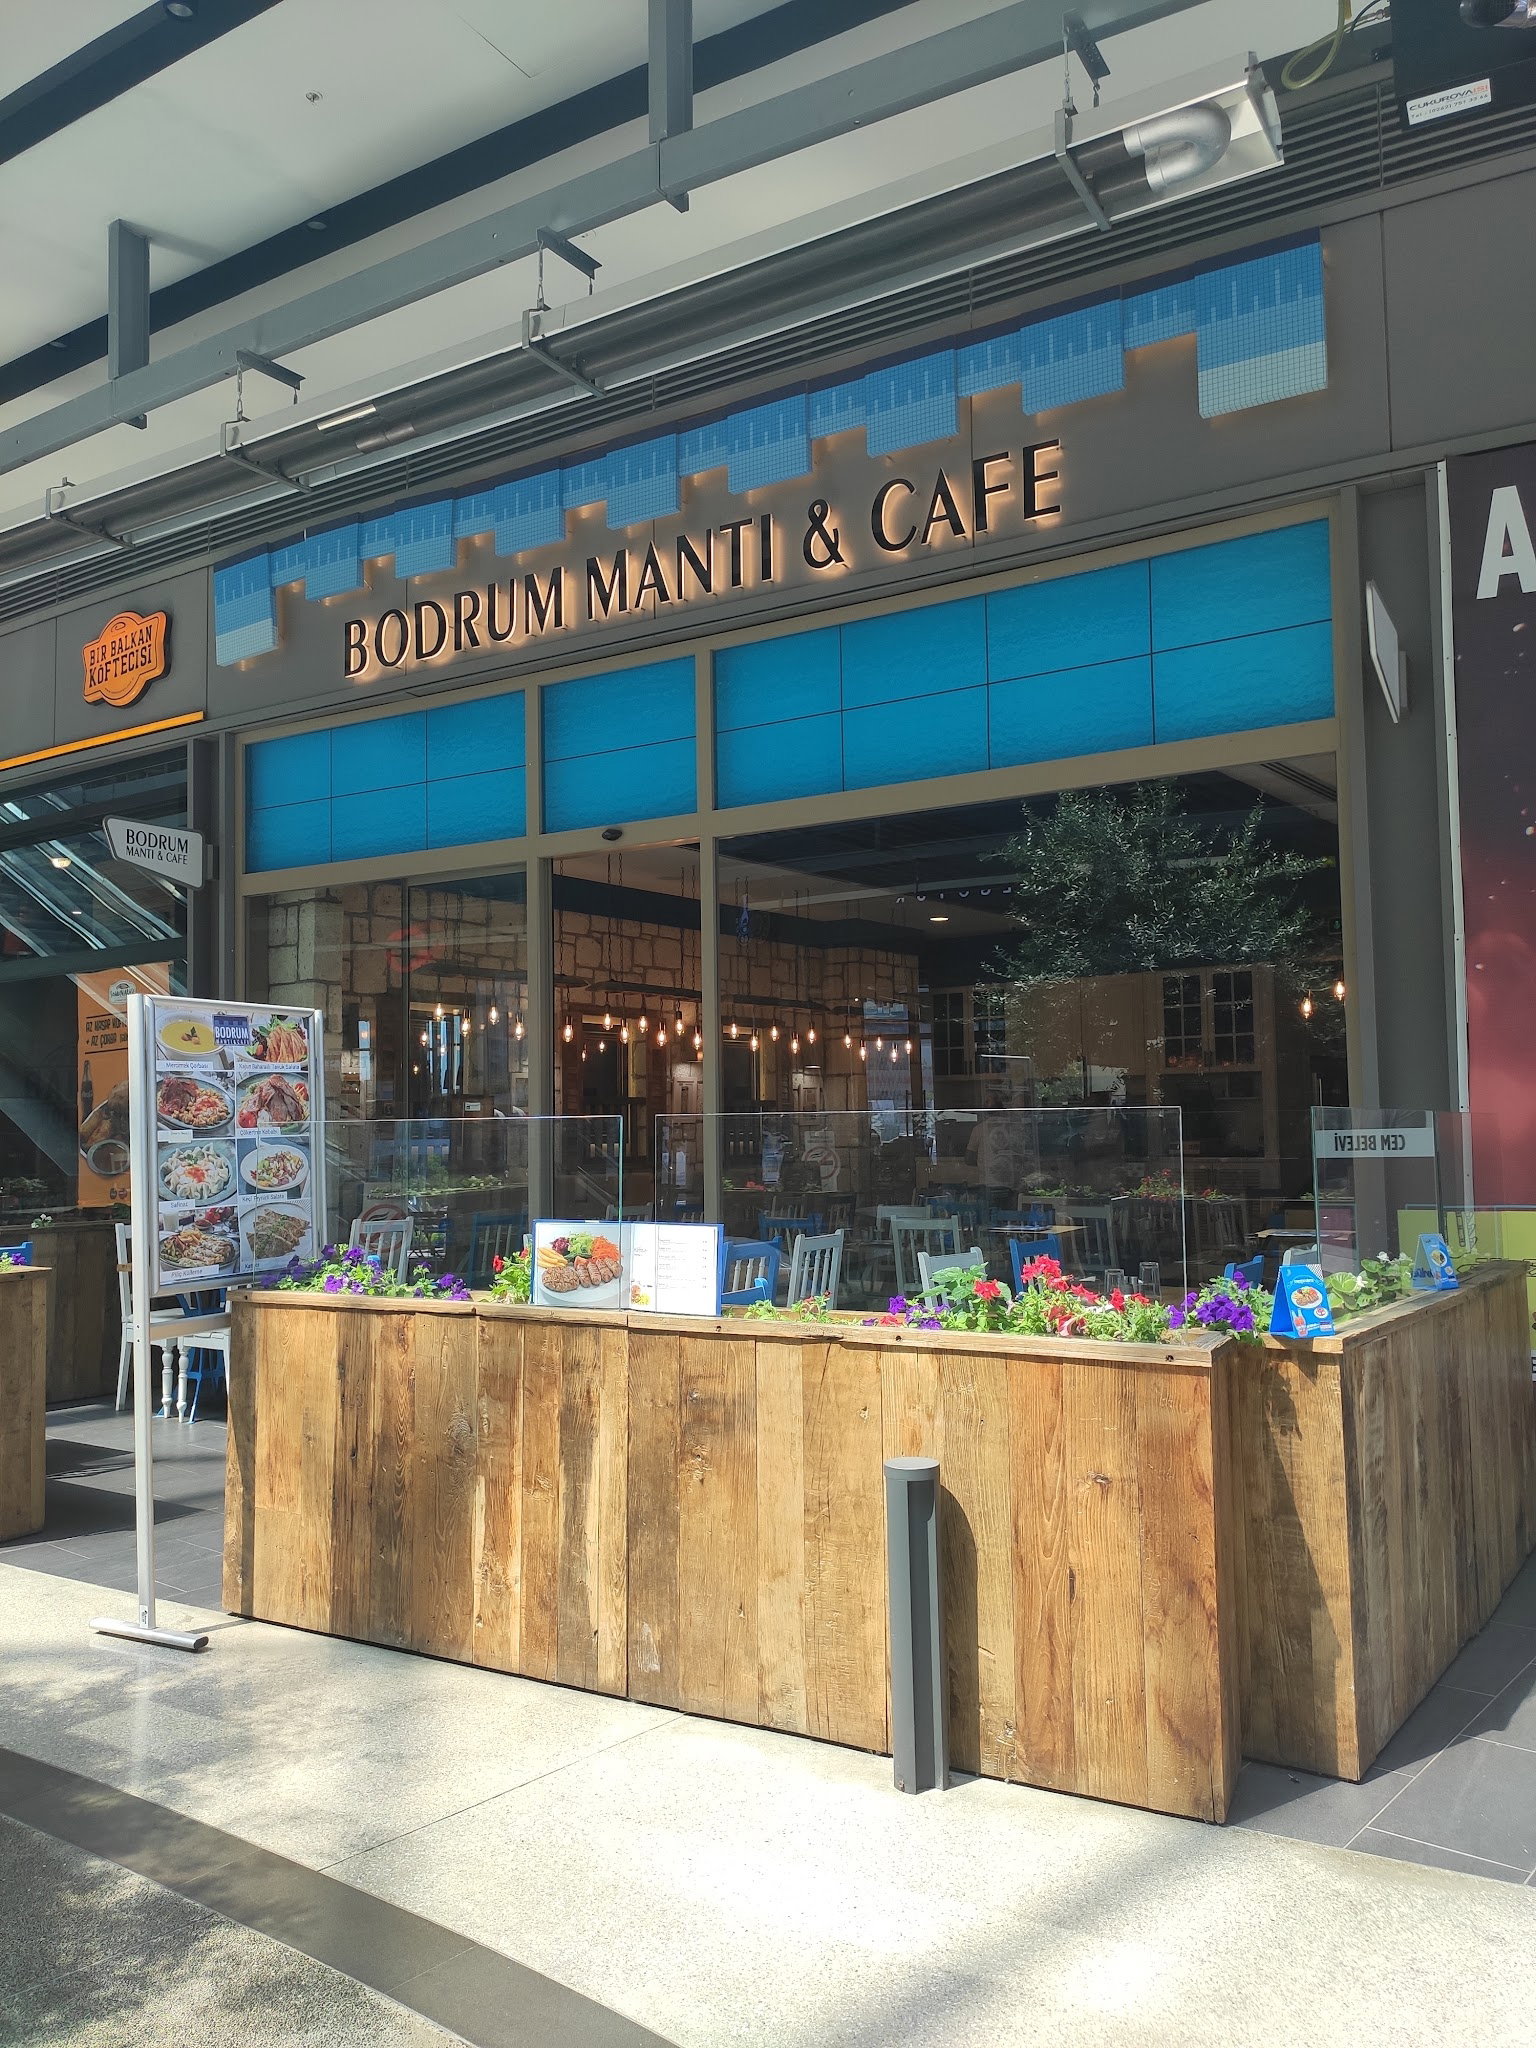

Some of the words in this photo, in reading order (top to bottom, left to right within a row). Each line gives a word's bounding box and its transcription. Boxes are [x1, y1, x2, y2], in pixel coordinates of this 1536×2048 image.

[344, 566, 566, 679] BODRUM
[586, 513, 774, 622] MANTI
[802, 498, 848, 570] &
[871, 438, 1062, 553] CAFE
[111, 625, 153, 658] BALKAN
[126, 828, 188, 854] BODRUM
[126, 845, 154, 860] MANTI
[157, 850, 163, 861] &
[166, 852, 188, 865] CAFE
[215, 1026, 249, 1039] BODRUM
